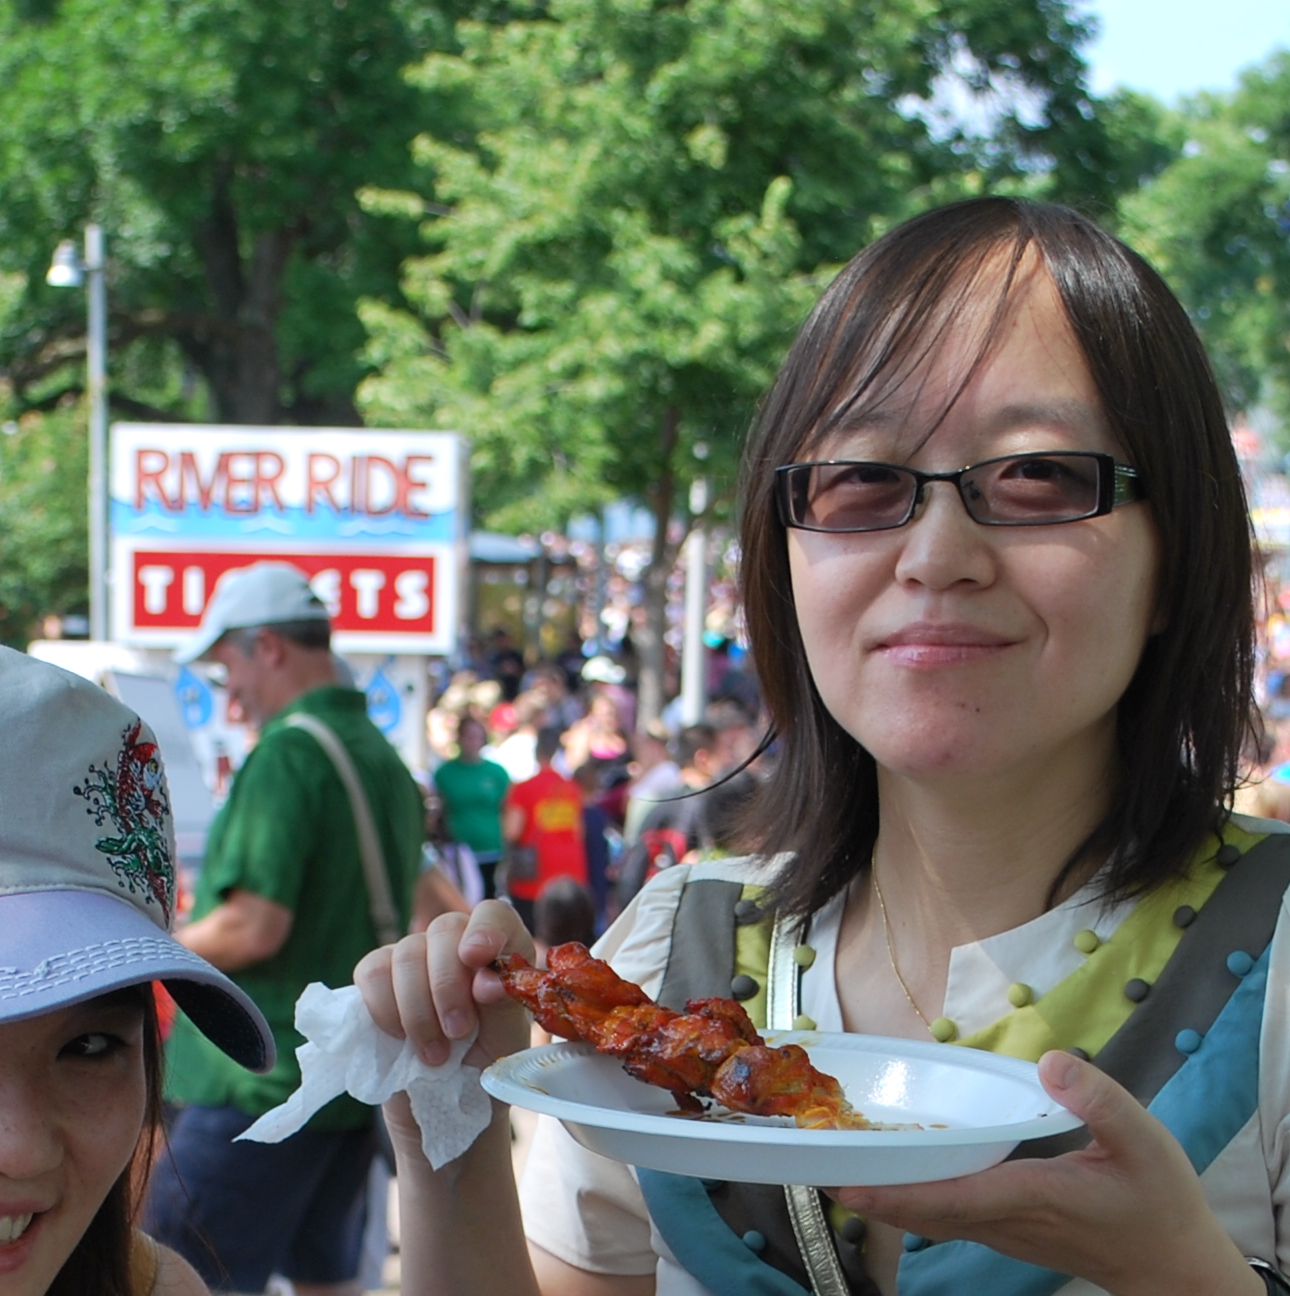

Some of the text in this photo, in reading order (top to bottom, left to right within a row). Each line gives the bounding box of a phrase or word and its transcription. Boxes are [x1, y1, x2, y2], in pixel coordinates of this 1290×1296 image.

[134, 449, 435, 520] RIVER RIDE
[137, 564, 430, 620] TIETS
